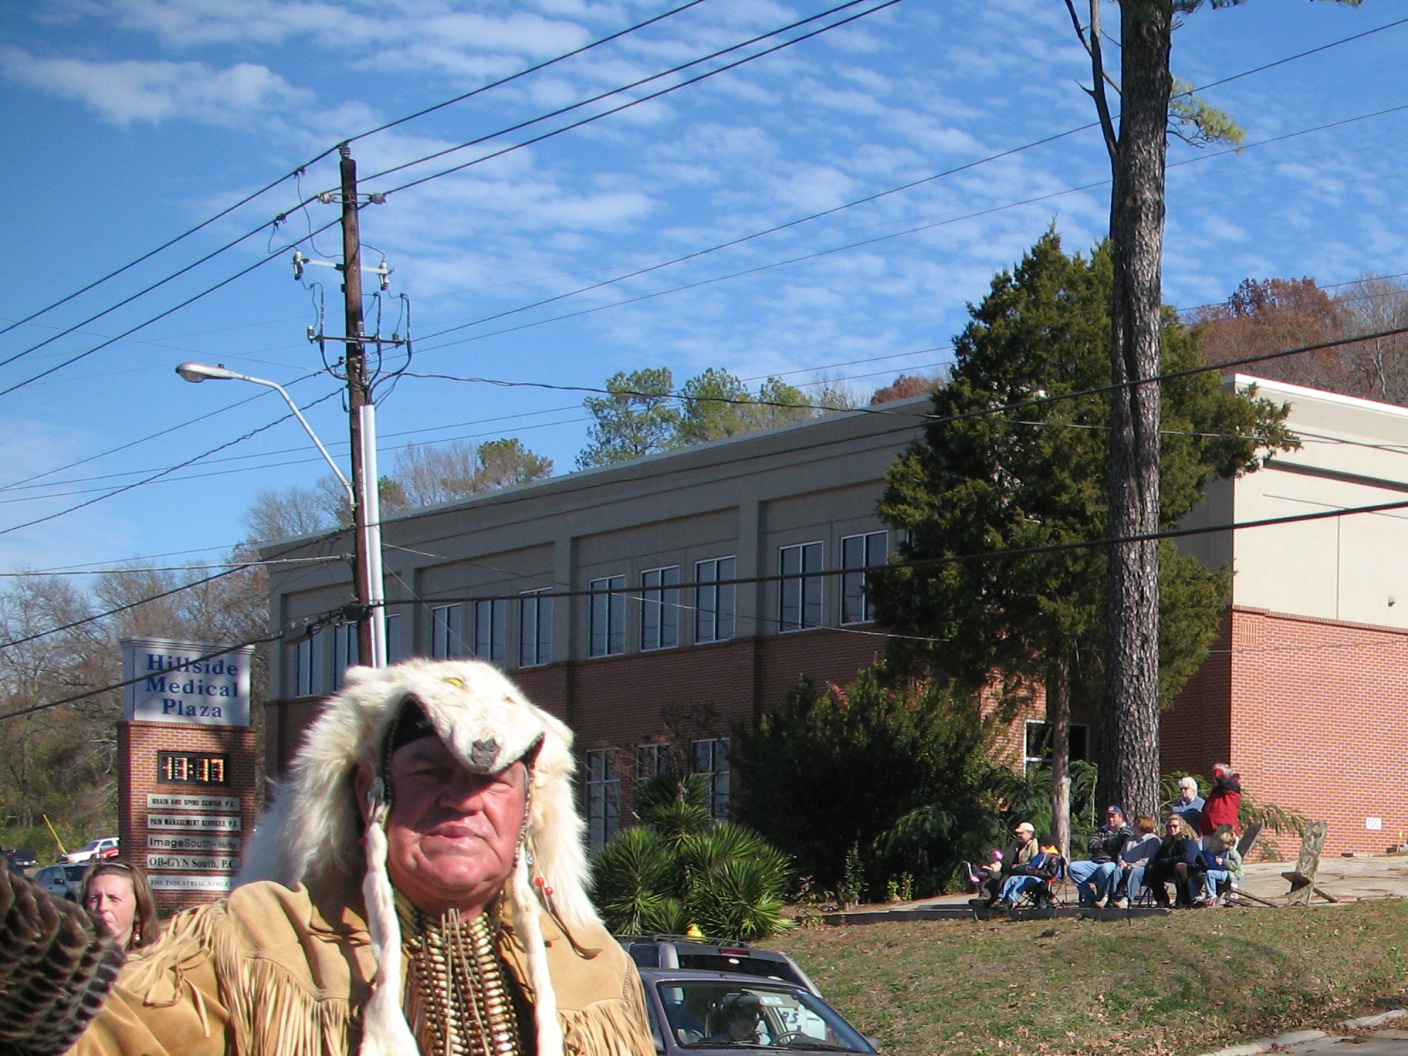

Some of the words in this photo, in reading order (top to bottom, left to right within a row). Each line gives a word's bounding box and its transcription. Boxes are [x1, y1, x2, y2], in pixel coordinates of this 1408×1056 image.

[146, 653, 238, 676] Hillside
[145, 676, 238, 698] Medical
[161, 698, 223, 718] Plaza
[150, 818, 162, 826] PAIN
[149, 857, 189, 867] OB-GYN
